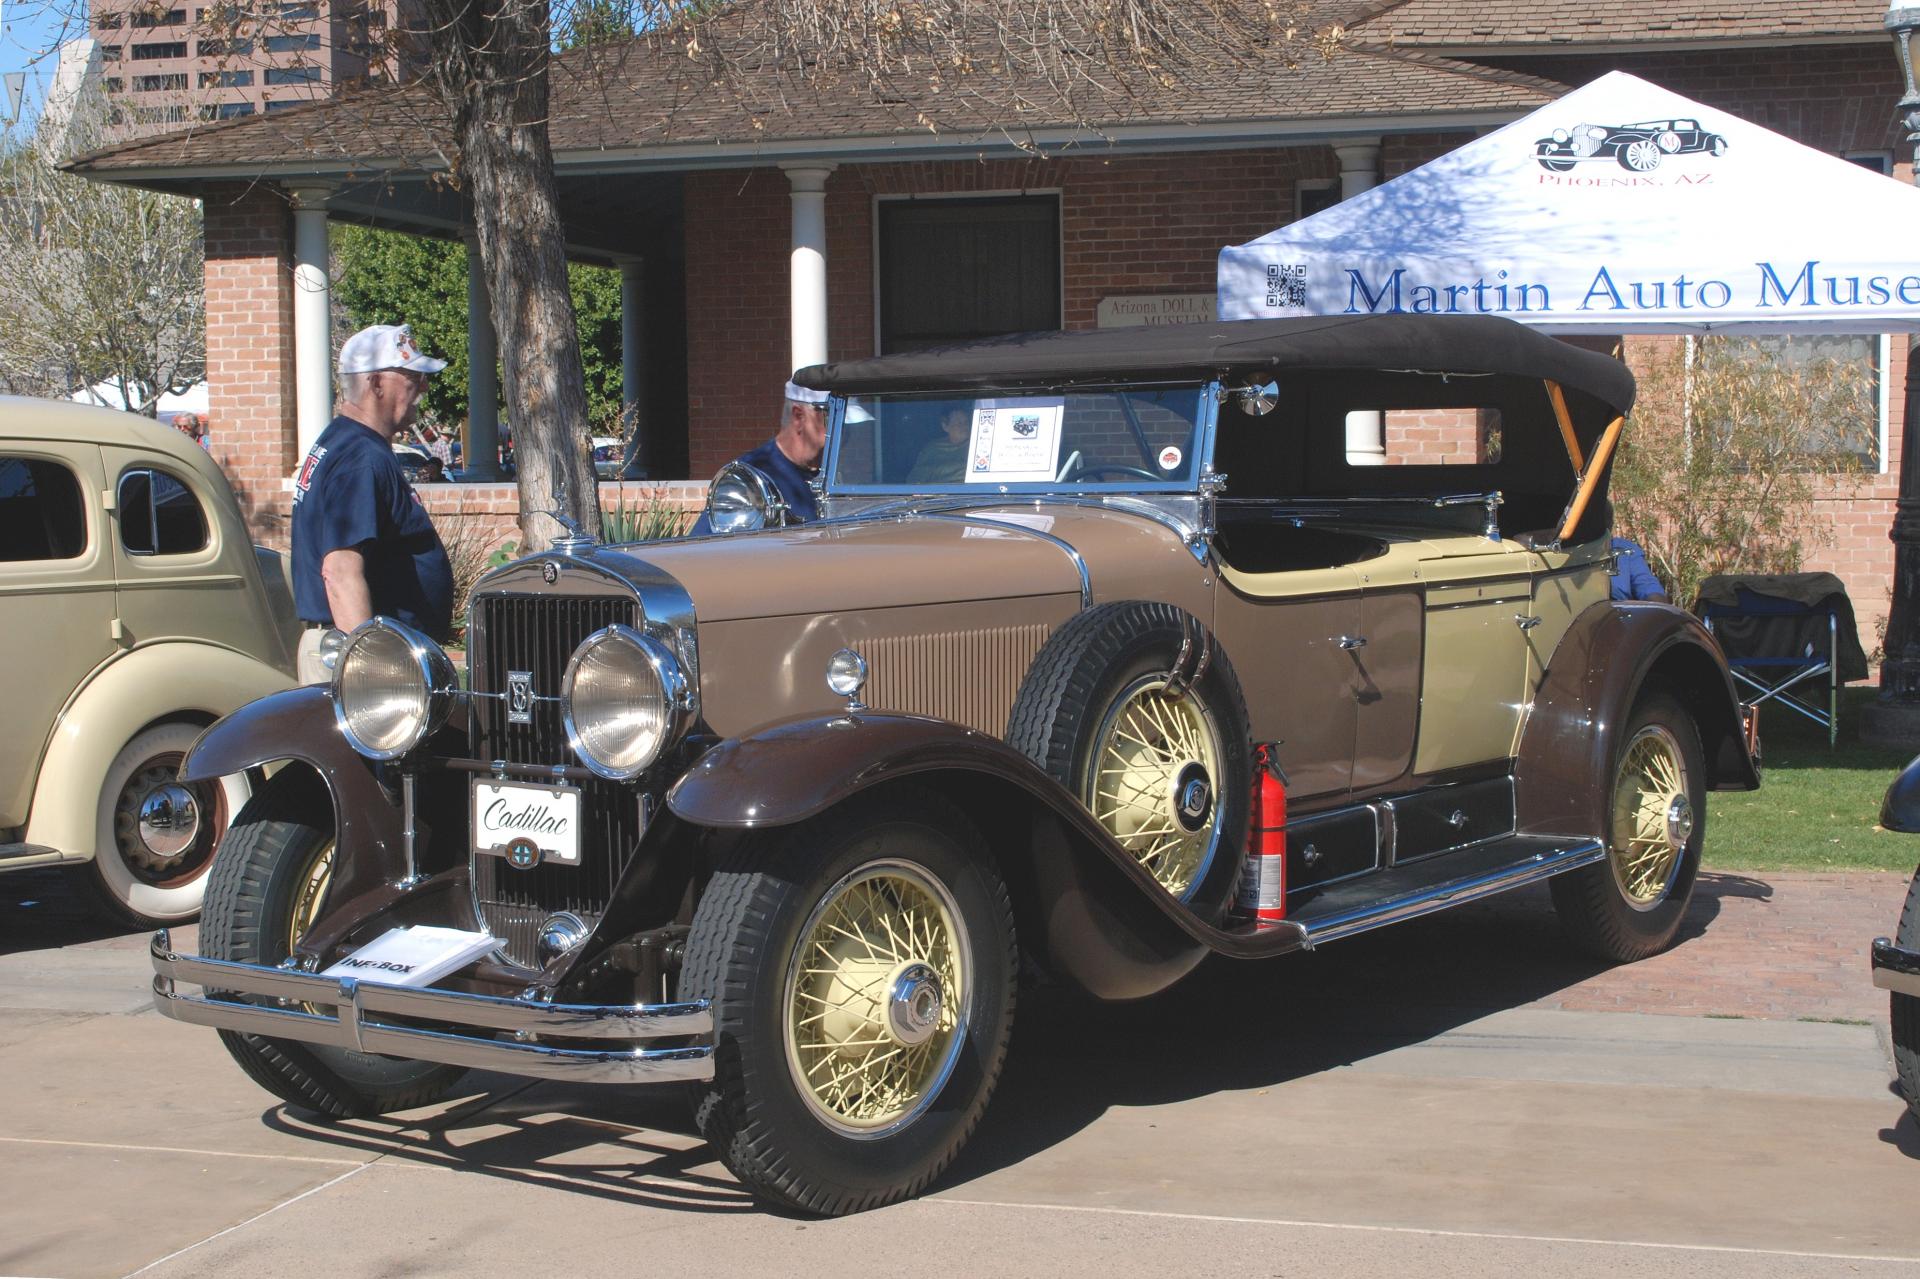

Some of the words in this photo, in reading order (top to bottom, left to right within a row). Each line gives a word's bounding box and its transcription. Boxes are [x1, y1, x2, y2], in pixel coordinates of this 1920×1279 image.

[1674, 173, 1714, 186] AZ
[1343, 268, 1554, 314] Martin
[1575, 265, 1732, 311] Auto
[1112, 300, 1156, 314] Arizona
[1162, 298, 1195, 314] DOLL
[484, 798, 568, 836] Cadillac
